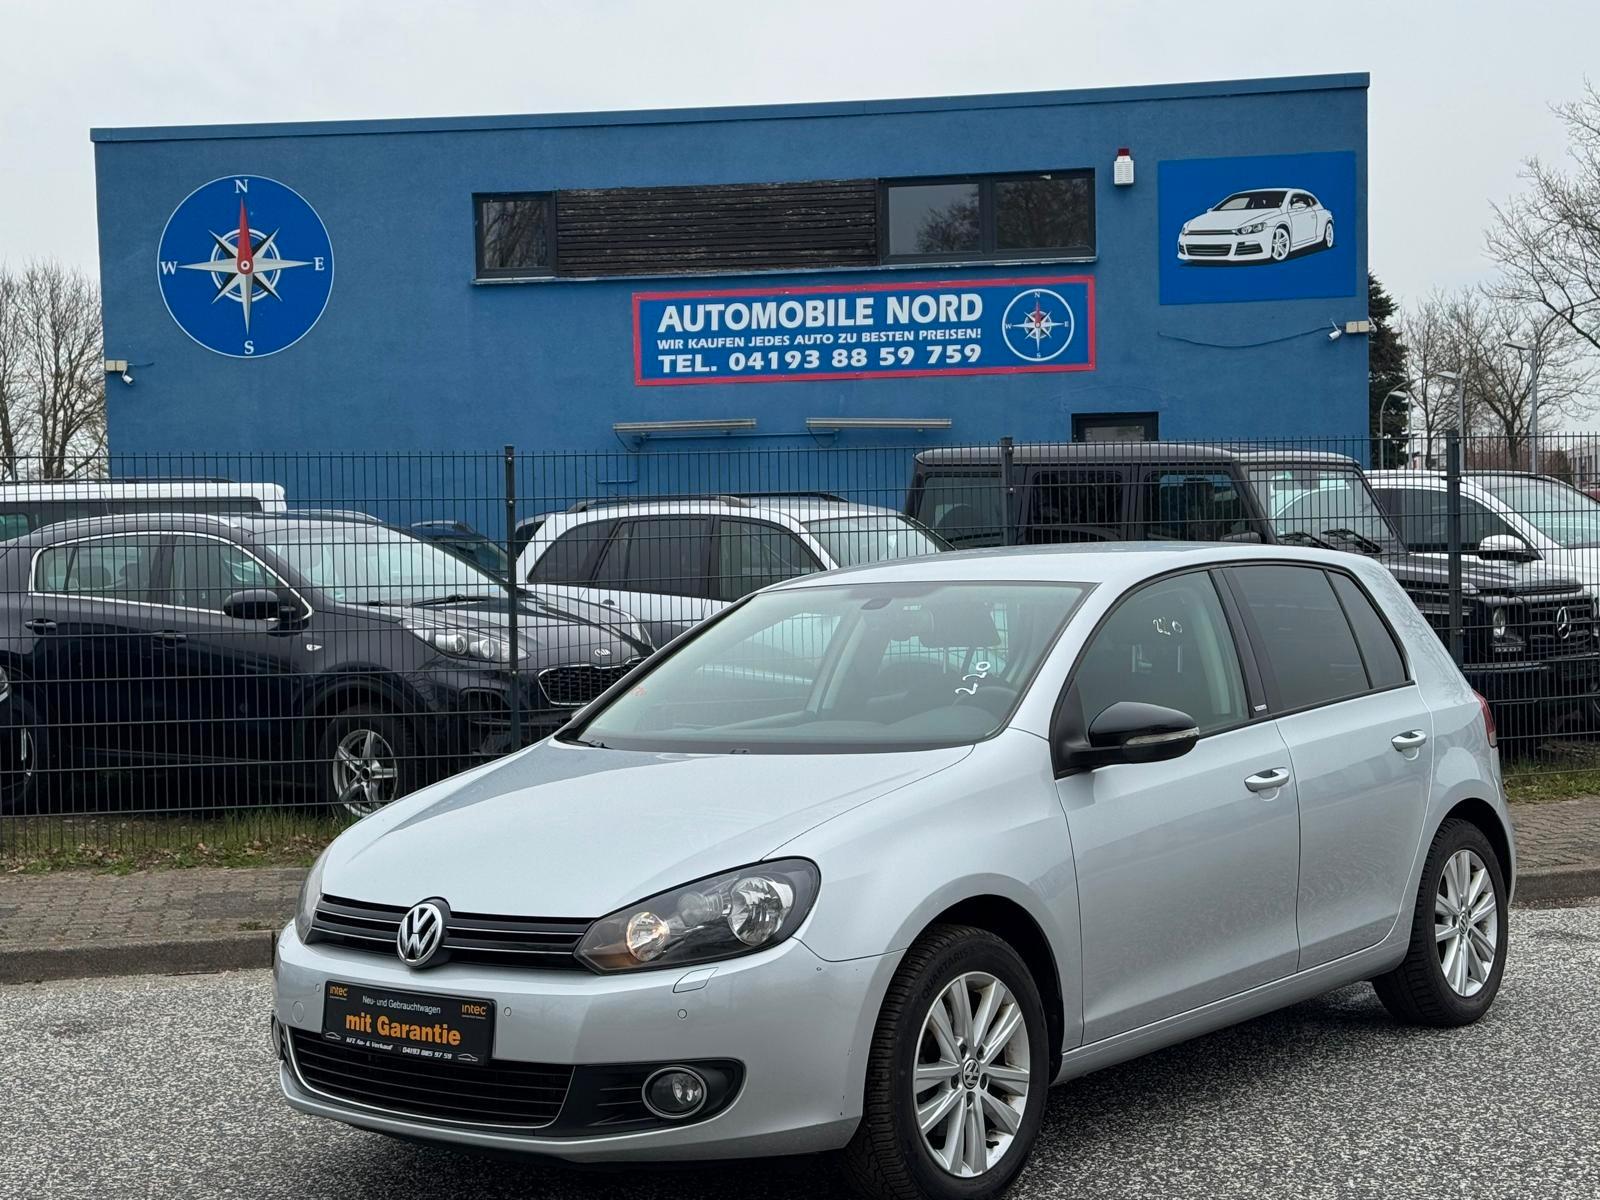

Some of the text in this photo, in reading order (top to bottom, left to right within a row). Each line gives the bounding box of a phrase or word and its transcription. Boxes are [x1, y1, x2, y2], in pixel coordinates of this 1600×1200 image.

[235, 179, 248, 194] N
[160, 261, 178, 275] W
[314, 257, 325, 271] E
[657, 293, 983, 332] AUTOMOBILE NORD
[657, 327, 982, 349] WIR KAUFEN JEDES AUTO ZU BESTEN PREISEN!
[244, 341, 254, 355] S
[658, 343, 982, 373] TEL. 04193 88 59 759
[362, 995, 441, 1015] Neu- und Gebrauchtwagen
[461, 1003, 487, 1015] intec
[346, 1011, 461, 1046] mit Garantie
